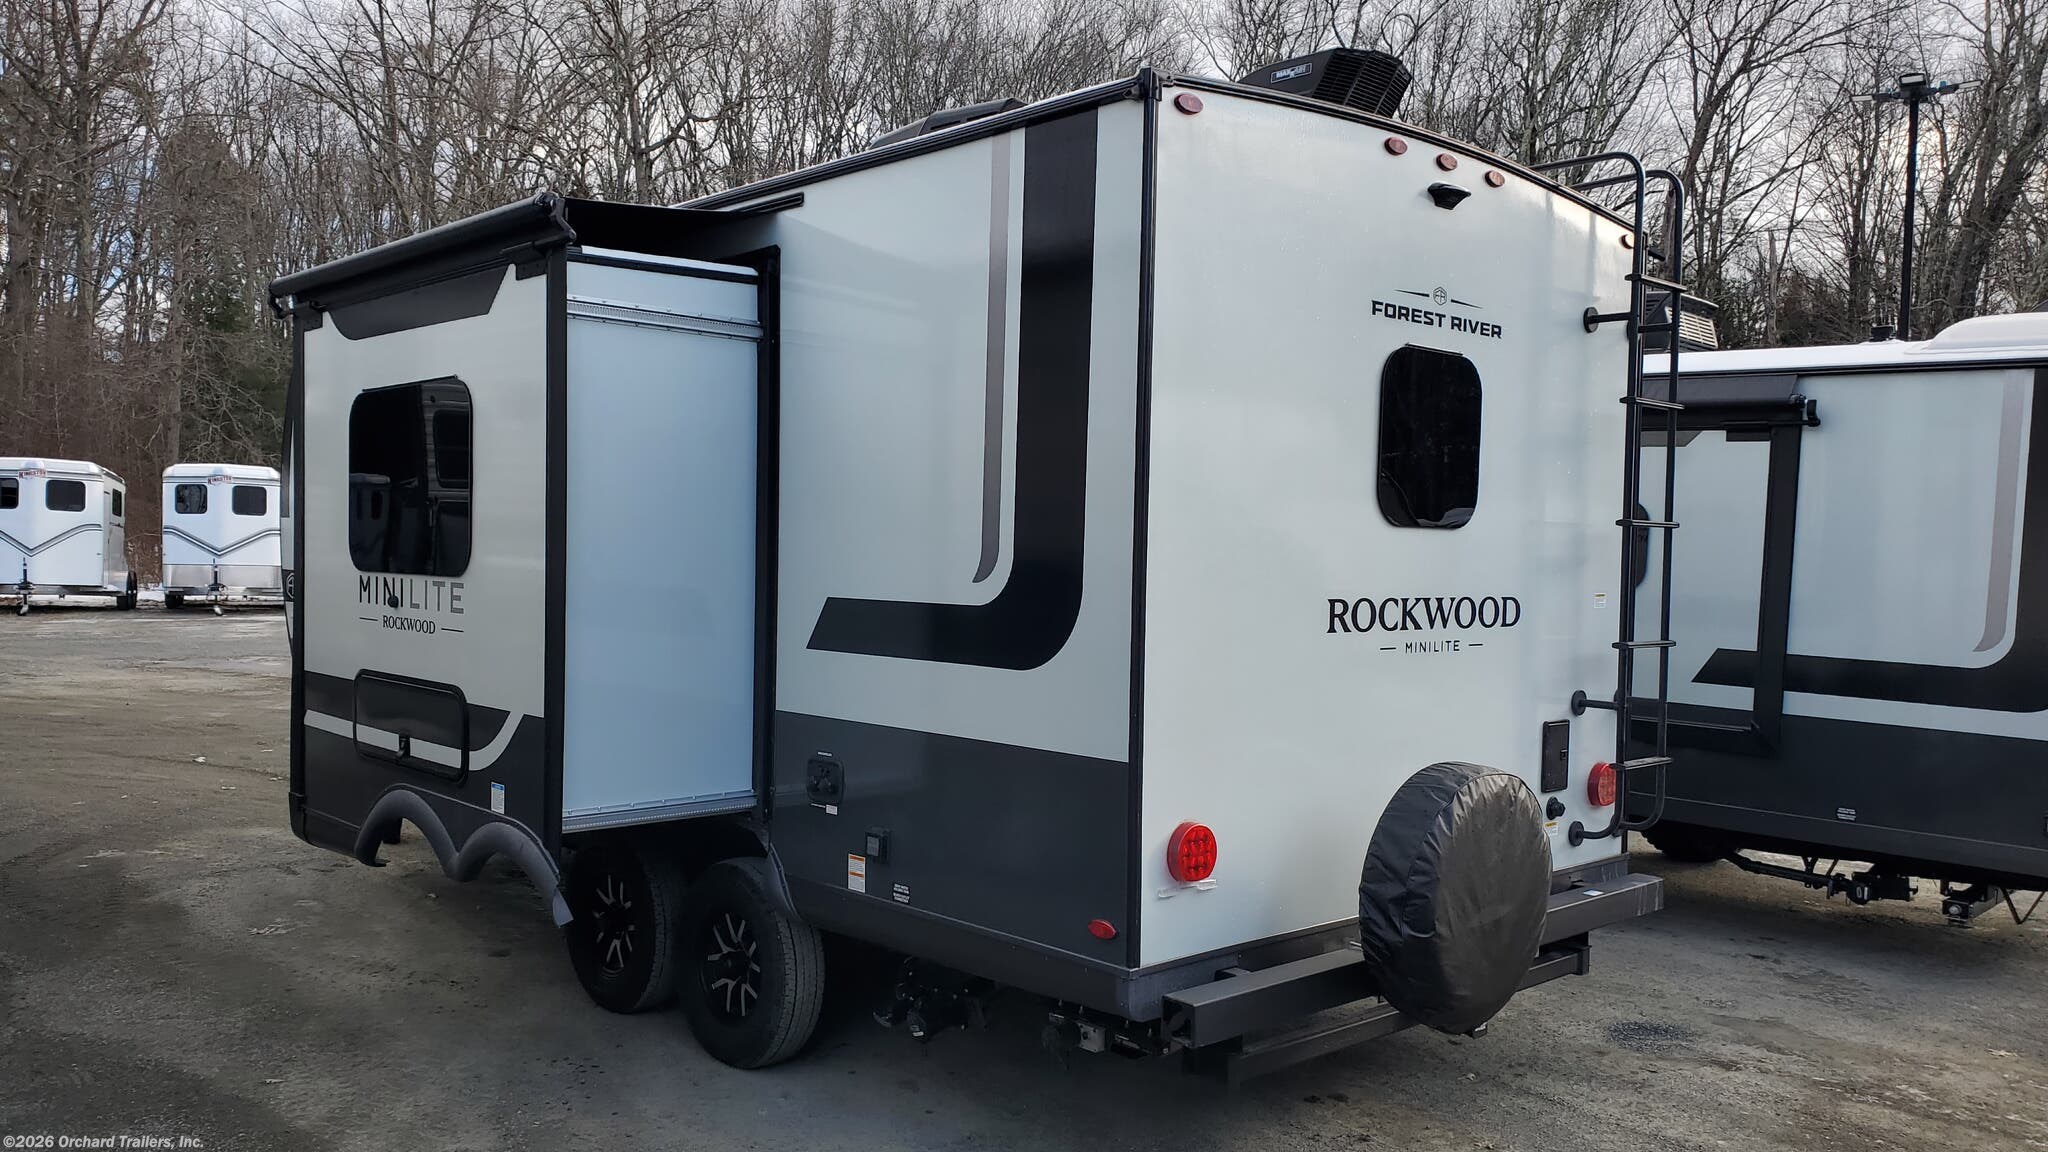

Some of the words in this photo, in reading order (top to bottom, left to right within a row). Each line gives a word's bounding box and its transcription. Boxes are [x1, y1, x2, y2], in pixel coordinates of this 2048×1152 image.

[1371, 299, 1446, 328] FOREST
[1450, 315, 1503, 340] RIVER
[359, 574, 465, 615] MINILITE
[382, 614, 437, 635] ROCKWOOD
[1326, 596, 1521, 634] ROCKWOOD
[1405, 639, 1461, 654] MINILITE
